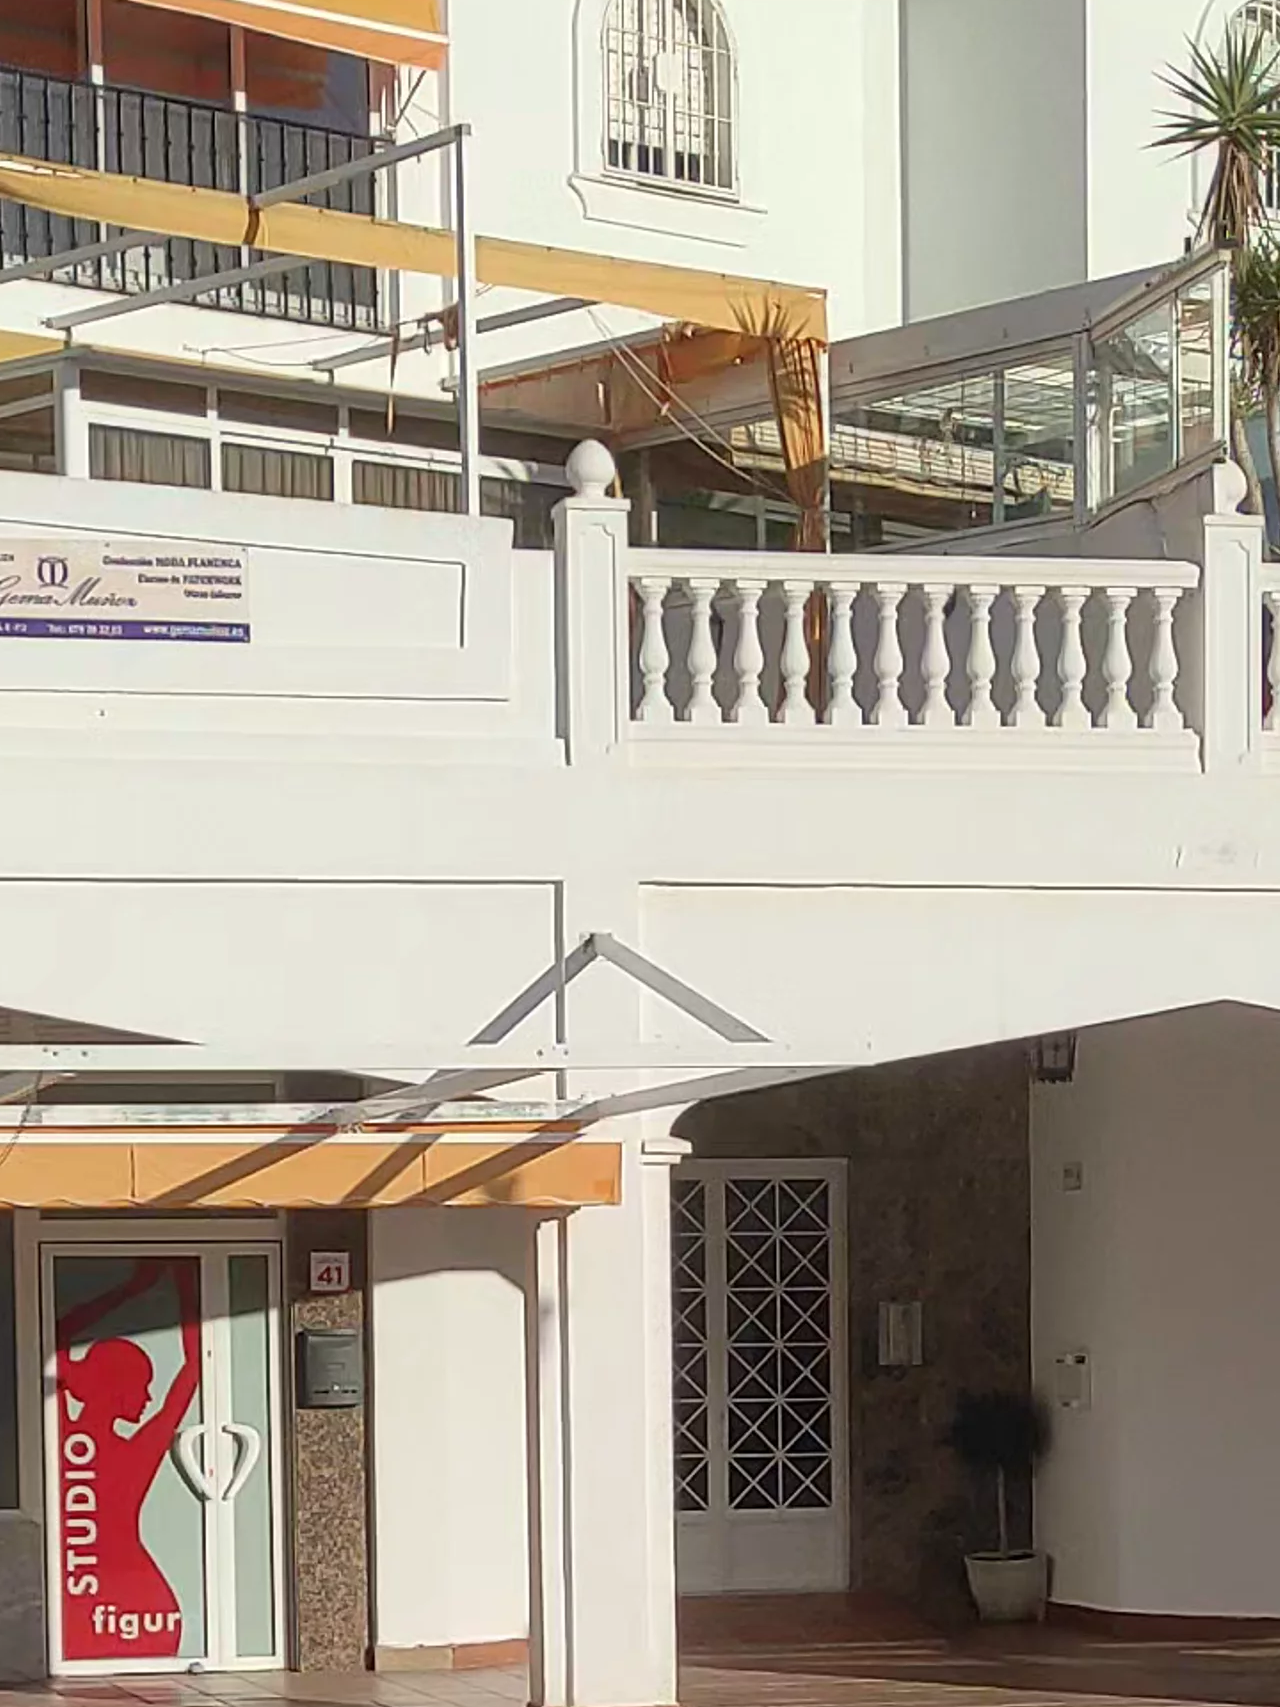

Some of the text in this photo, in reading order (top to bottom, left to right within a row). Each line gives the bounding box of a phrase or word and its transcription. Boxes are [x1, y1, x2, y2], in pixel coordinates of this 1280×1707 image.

[187, 557, 241, 569] FLAMENCA
[54, 577, 137, 607] Muñoz
[317, 1265, 342, 1285] 41
[63, 1433, 100, 1596] STUDIO
[92, 1604, 182, 1641] figur
